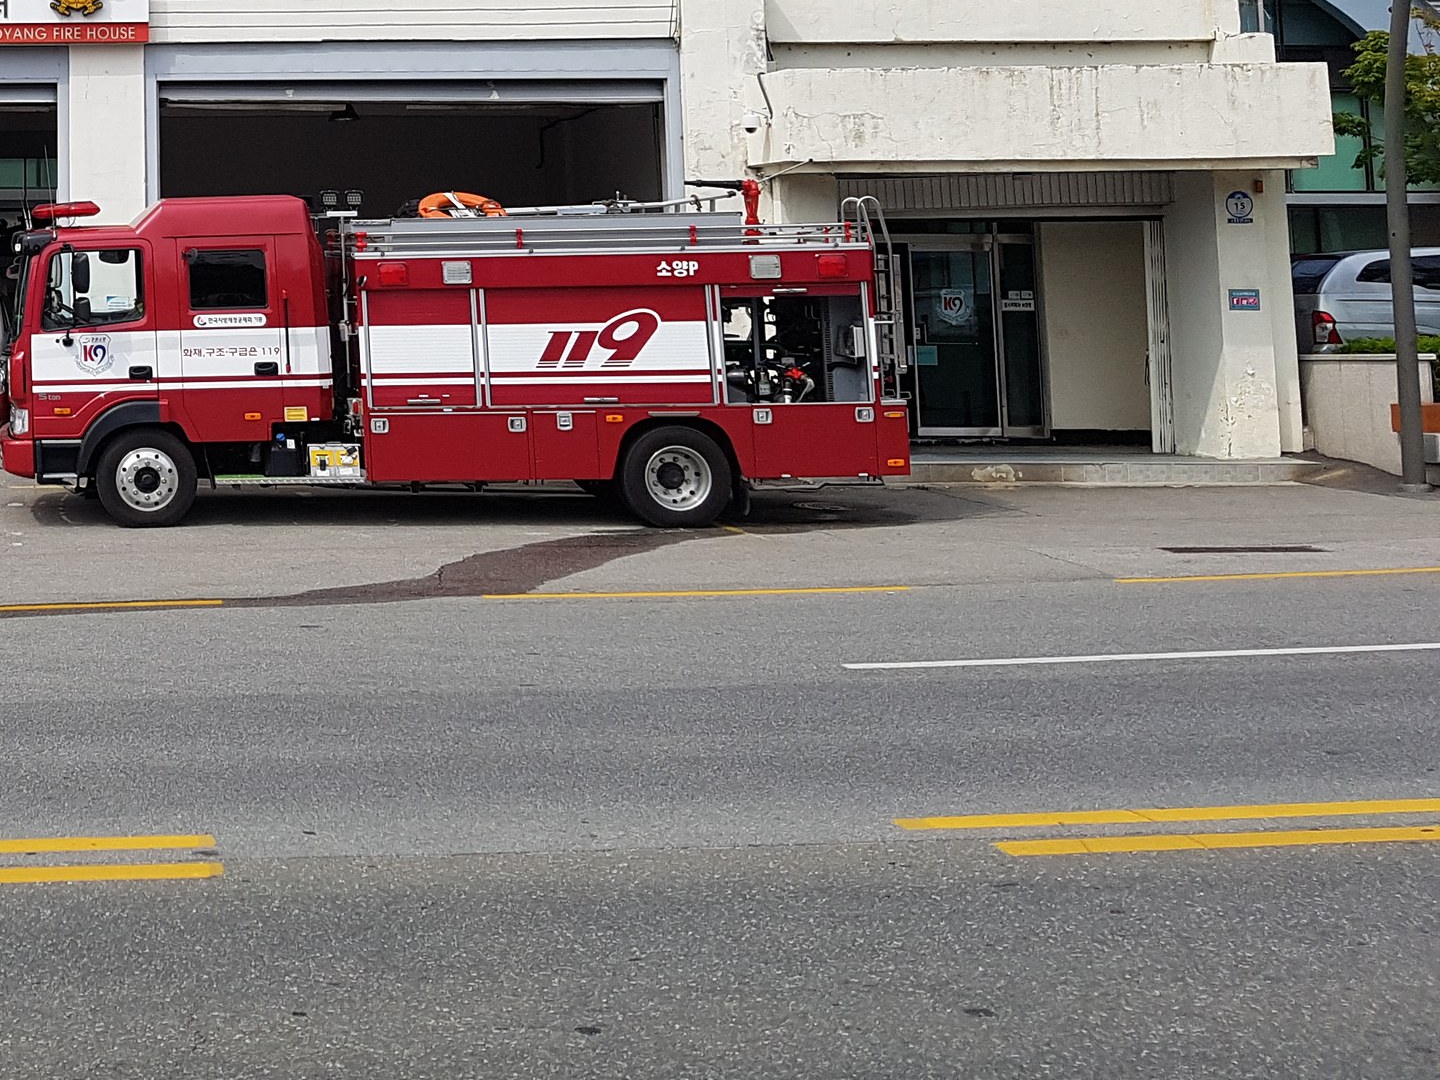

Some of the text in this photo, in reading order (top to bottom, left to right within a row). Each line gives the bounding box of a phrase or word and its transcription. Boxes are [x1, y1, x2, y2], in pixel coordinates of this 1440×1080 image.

[53, 27, 83, 40] FIRE
[87, 26, 136, 40] HOUSE
[656, 260, 699, 277] 소양P
[535, 312, 659, 368] 119
[262, 347, 280, 356] 119
